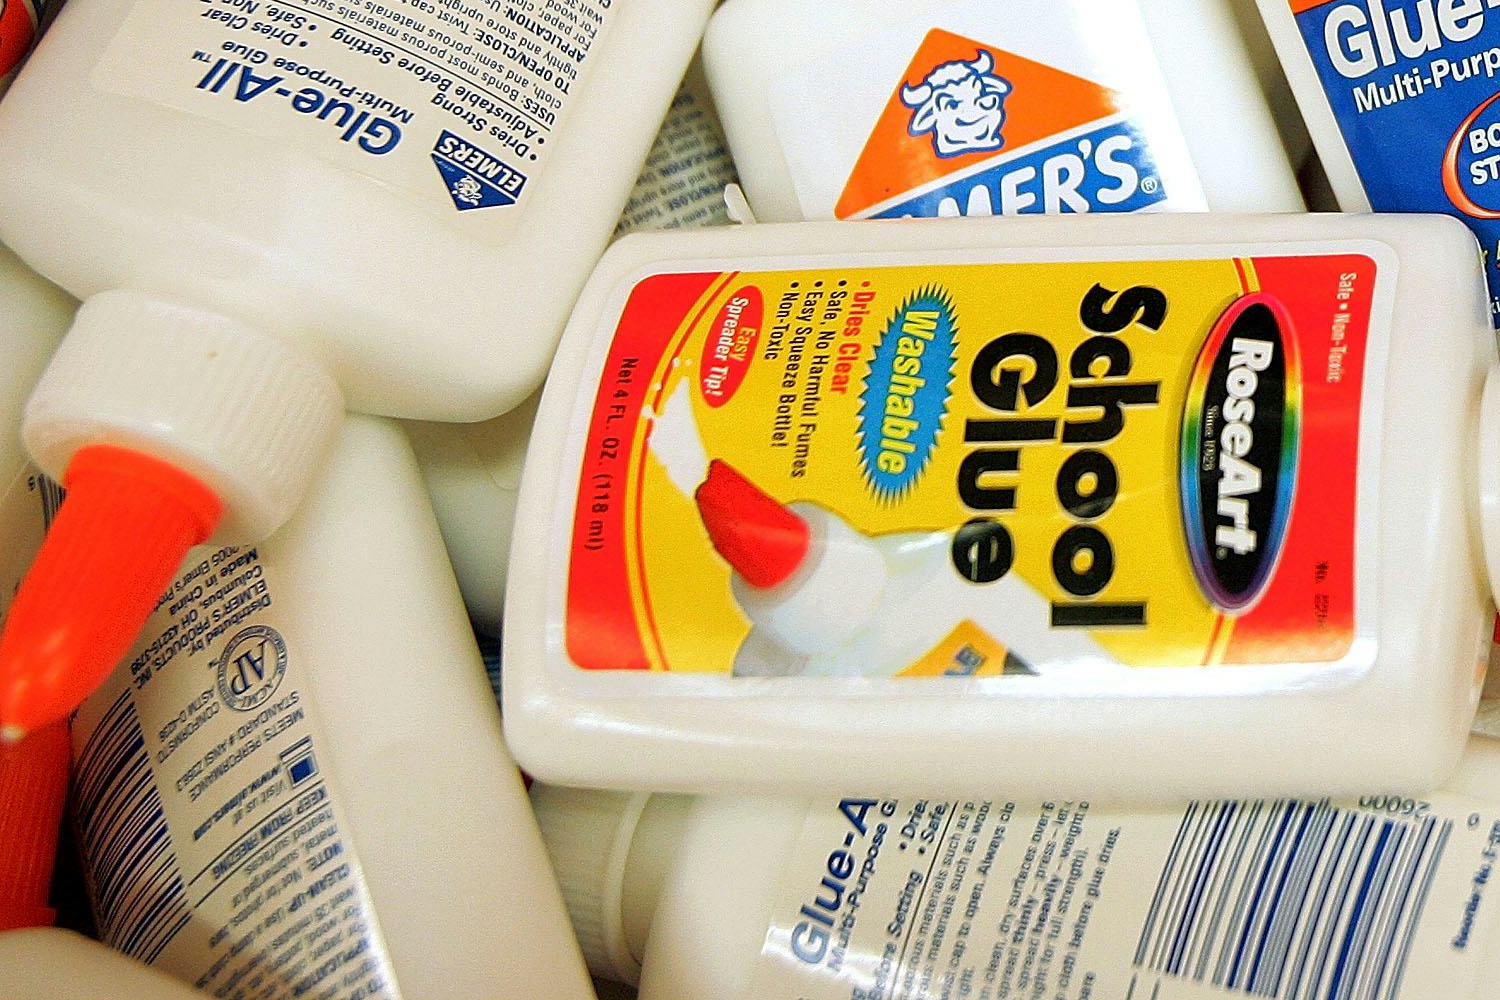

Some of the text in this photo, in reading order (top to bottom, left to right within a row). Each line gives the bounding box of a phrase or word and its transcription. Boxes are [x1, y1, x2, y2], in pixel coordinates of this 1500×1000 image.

[201, 9, 298, 45] Dries Clear
[266, 5, 306, 29] Safe,
[337, 7, 398, 36] materials
[401, 33, 447, 58] porous
[222, 42, 414, 123] Multi-Purpose Glue
[330, 28, 538, 139] Adjustable Before Setting
[447, 55, 479, 75] most
[481, 73, 519, 101] Bonds
[431, 93, 529, 157] Dries Strong
[521, 98, 555, 125] USES:
[435, 138, 522, 191] ELMER'S
[705, 298, 748, 395] Spreader Tip!
[730, 328, 756, 361] Easy
[765, 293, 799, 359] Non-Toxic
[831, 292, 876, 394] Dries Clear
[1327, 273, 1356, 382] Safe Non-Toxic
[613, 390, 629, 398] 4
[616, 359, 639, 383] Net
[772, 292, 823, 446] Easy Squeeze Bottle!
[791, 291, 847, 477] Safe, No Harmful Fumes
[877, 308, 937, 476] Washable
[952, 332, 1058, 584] Glue
[1051, 281, 1166, 629] School
[592, 474, 613, 513] (118
[584, 520, 604, 550] ml)
[792, 798, 879, 964] Glue-A
